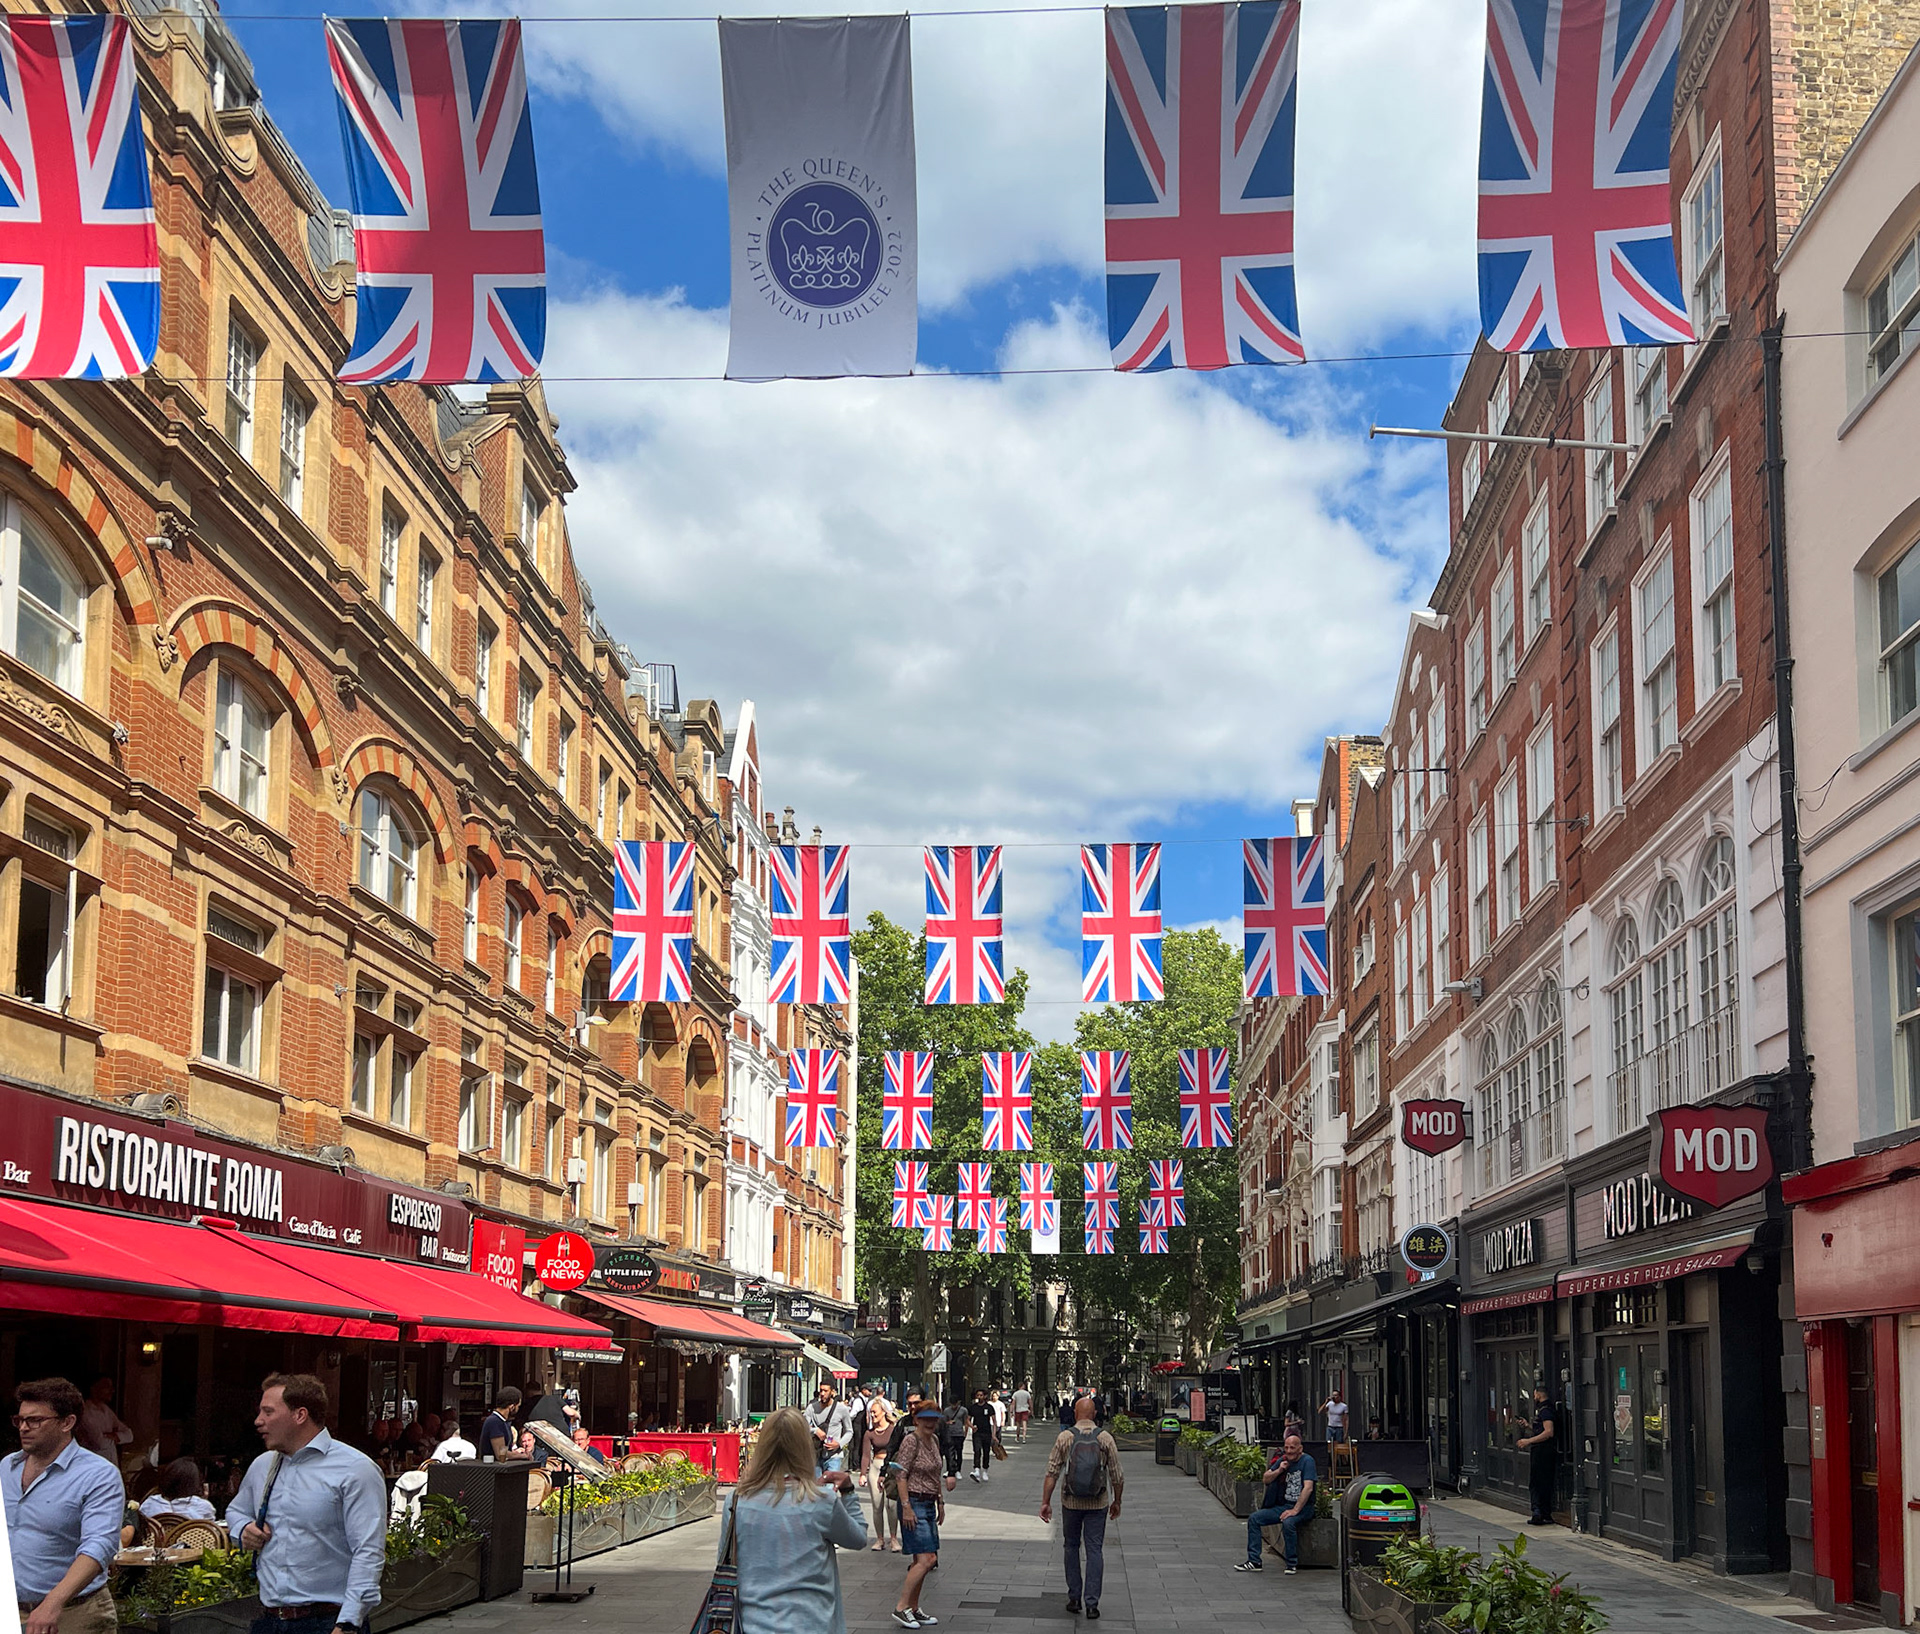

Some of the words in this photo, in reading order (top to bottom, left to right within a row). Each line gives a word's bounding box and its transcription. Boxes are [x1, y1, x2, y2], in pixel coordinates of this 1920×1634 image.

[757, 168, 796, 206] THE
[802, 158, 889, 209] QUEEN'S
[747, 232, 810, 323] PLATINUM
[817, 283, 892, 330] JUBILEE
[886, 230, 902, 278] 2022
[1411, 1111, 1457, 1136] MOD
[1673, 1127, 1758, 1173] MOD
[3, 1160, 32, 1184] Bar
[57, 1116, 221, 1210] RISTORANTE
[223, 1157, 283, 1223] ROMA
[390, 1193, 442, 1233] ESPRESSO
[1603, 1176, 1638, 1240] MOD
[287, 1216, 309, 1235] Casa
[420, 1235, 439, 1259] BAR
[1483, 1228, 1505, 1274] MOD
[1505, 1218, 1534, 1270] PIZZA
[487, 1253, 516, 1276] FOOD
[546, 1259, 581, 1269] FOOD
[604, 1268, 630, 1276] LITTLE
[631, 1269, 653, 1277] ITALY
[608, 1254, 650, 1267] PIZZERIA
[540, 1269, 549, 1279] &
[550, 1269, 585, 1280] NEWS
[606, 1276, 650, 1291] RESTAURANT
[1569, 1271, 1640, 1294] SUPERFAST
[1645, 1264, 1671, 1281] PIZZA
[1674, 1262, 1682, 1274] &
[1684, 1254, 1723, 1272] SALAD
[790, 1300, 810, 1308] Bella
[790, 1309, 810, 1317] Italia
[1463, 1298, 1503, 1314] SUPERFAST
[1505, 1295, 1520, 1306] PIZZA
[1527, 1289, 1548, 1302] SALAD
